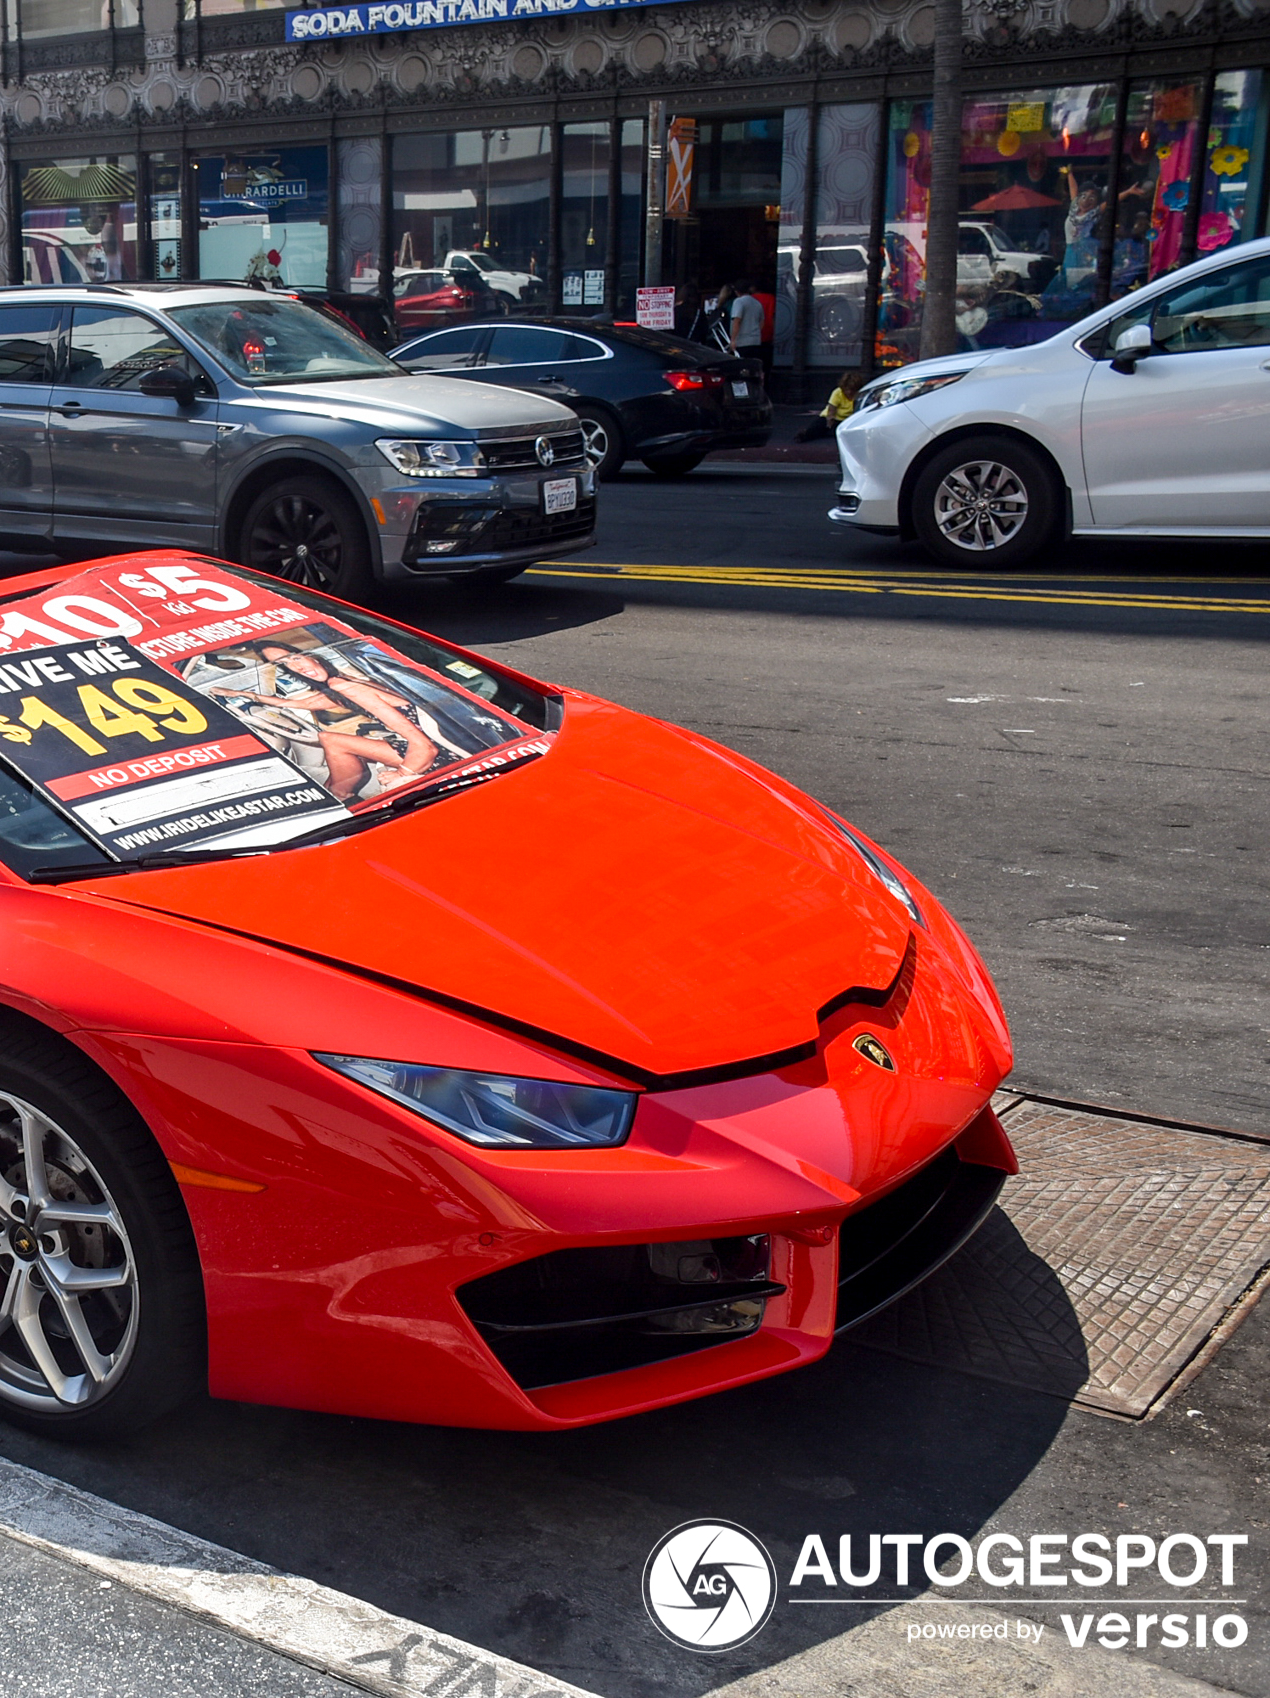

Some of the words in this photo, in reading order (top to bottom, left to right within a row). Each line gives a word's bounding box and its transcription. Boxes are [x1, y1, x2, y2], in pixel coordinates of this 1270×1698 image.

[292, 9, 365, 38] SODA
[368, 0, 508, 30] FOUNTAIN
[223, 184, 303, 199] RARDELLI
[638, 300, 650, 310] NO
[651, 301, 672, 310] STOPPING
[118, 565, 251, 612] $5
[161, 600, 197, 617] Kid
[133, 631, 206, 660] ICTURE
[188, 619, 253, 643] INSIDE
[234, 612, 281, 631] THE
[270, 607, 310, 623] CAR
[71, 641, 142, 675] ME
[88, 763, 130, 789] NO
[127, 744, 227, 779] DEPOSIT
[112, 788, 326, 852] WWW.IRIDELIKEASTAR.COM
